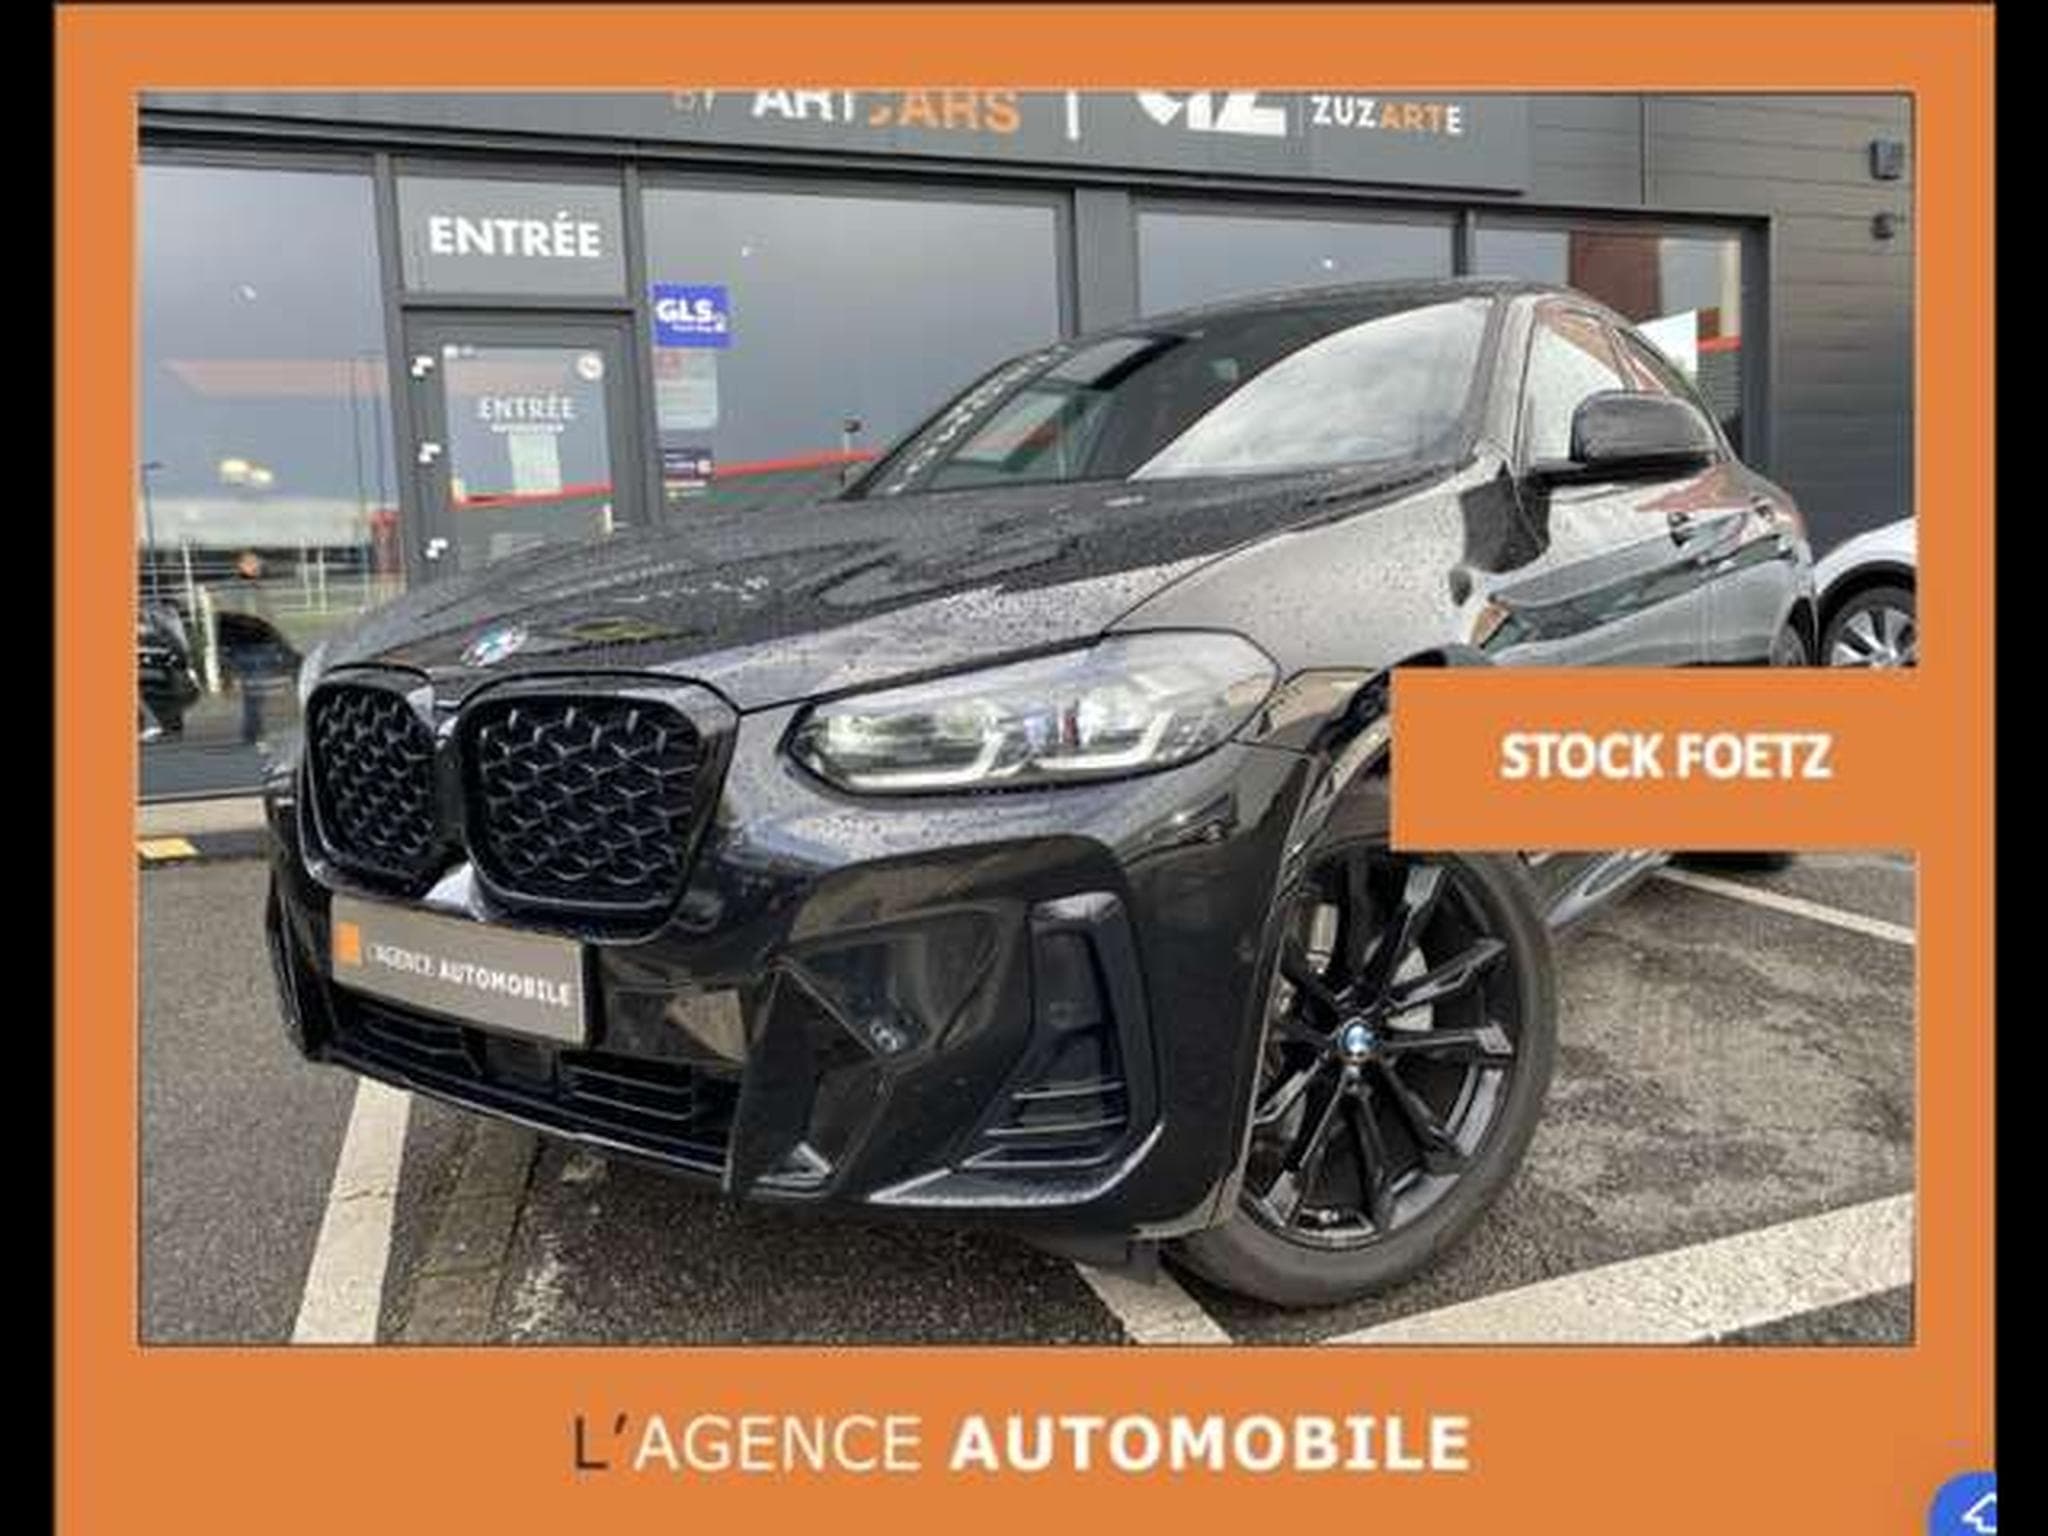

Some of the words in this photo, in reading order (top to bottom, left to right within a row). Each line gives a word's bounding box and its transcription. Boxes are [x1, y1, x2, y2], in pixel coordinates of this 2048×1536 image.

[1311, 96, 1463, 135] ZUZARTE
[428, 210, 602, 257] ENTRÉE
[477, 393, 577, 421] ENTRÉE
[438, 959, 573, 1008] AUTOMOBILE
